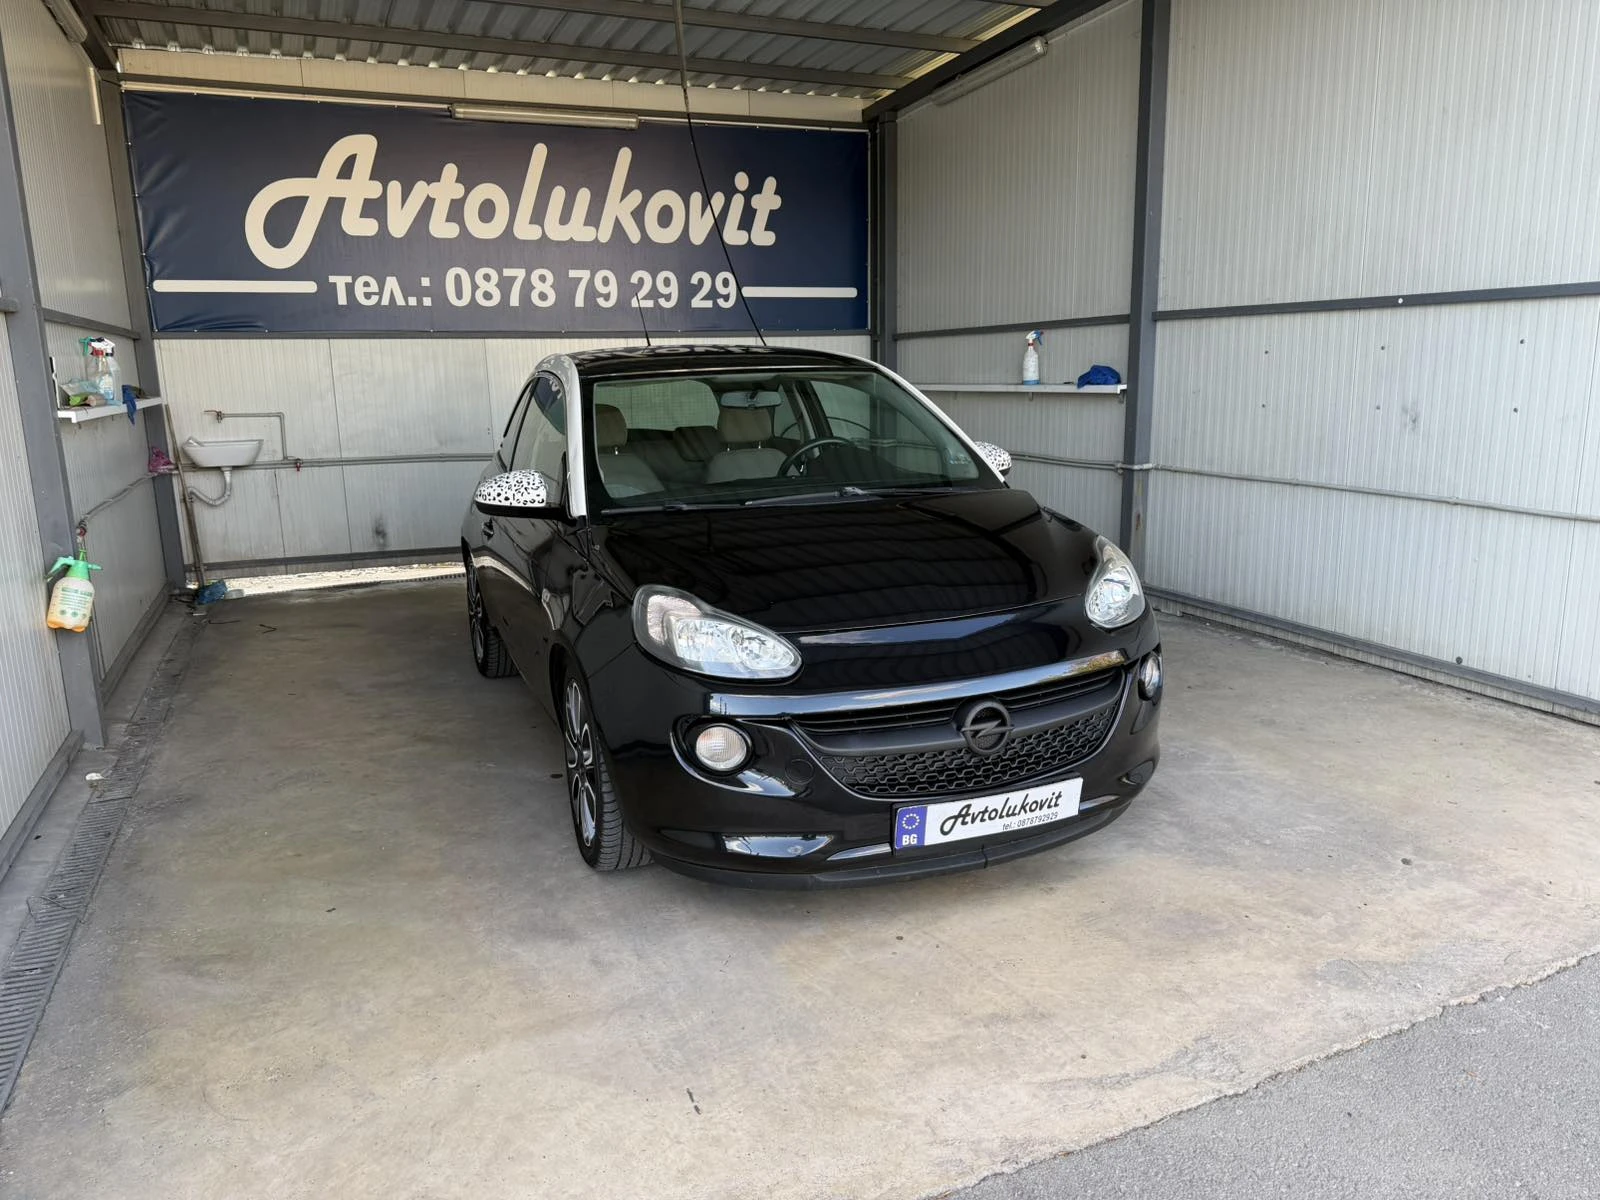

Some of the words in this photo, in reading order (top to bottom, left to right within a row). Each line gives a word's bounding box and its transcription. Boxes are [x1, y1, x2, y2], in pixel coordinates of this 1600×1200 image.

[245, 133, 782, 269] Avtolukovit
[328, 274, 432, 306] тел.:
[445, 267, 556, 308] 0878
[568, 269, 618, 308] 79
[630, 270, 679, 309] 29
[690, 271, 738, 309] 29
[940, 791, 1063, 836] Avtolukovit
[1002, 821, 1017, 831] tel.:
[1017, 811, 1058, 827] 0878792929
[902, 833, 918, 846] BG
